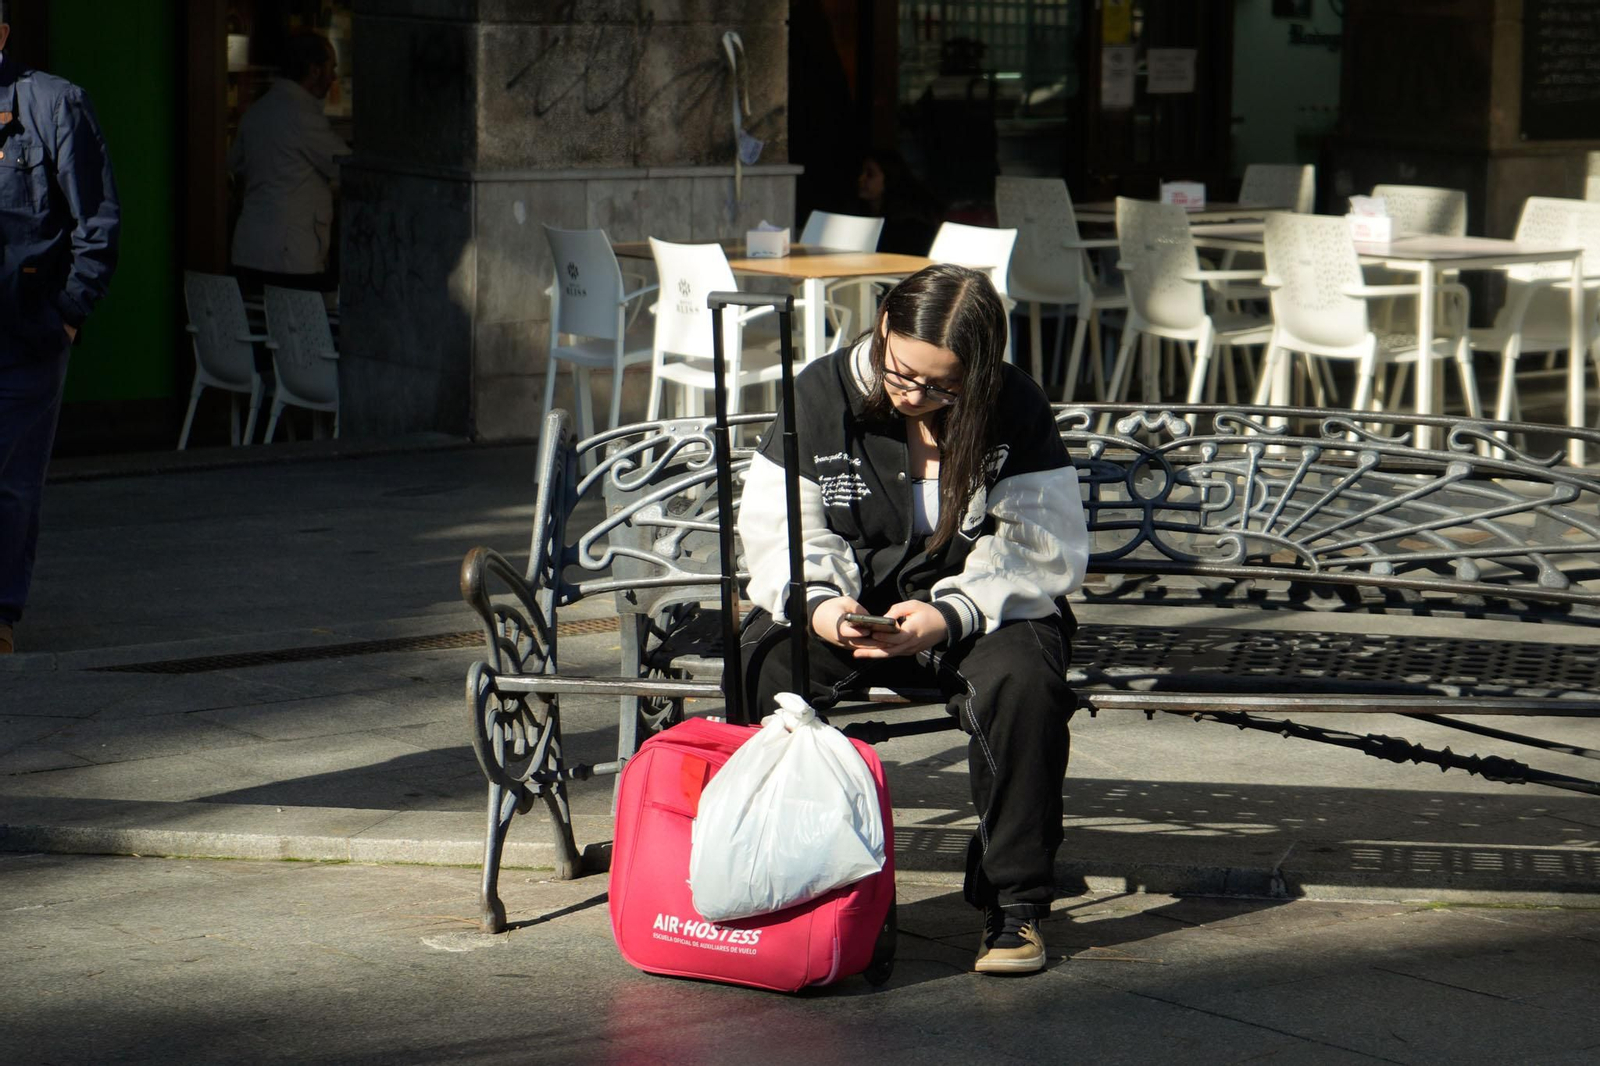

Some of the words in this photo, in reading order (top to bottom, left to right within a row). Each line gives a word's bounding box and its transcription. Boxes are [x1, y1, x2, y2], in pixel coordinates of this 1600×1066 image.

[653, 933, 673, 941] ESCUELA
[674, 938, 692, 946] OFICIAL
[700, 943, 730, 952] AUXILIARES
